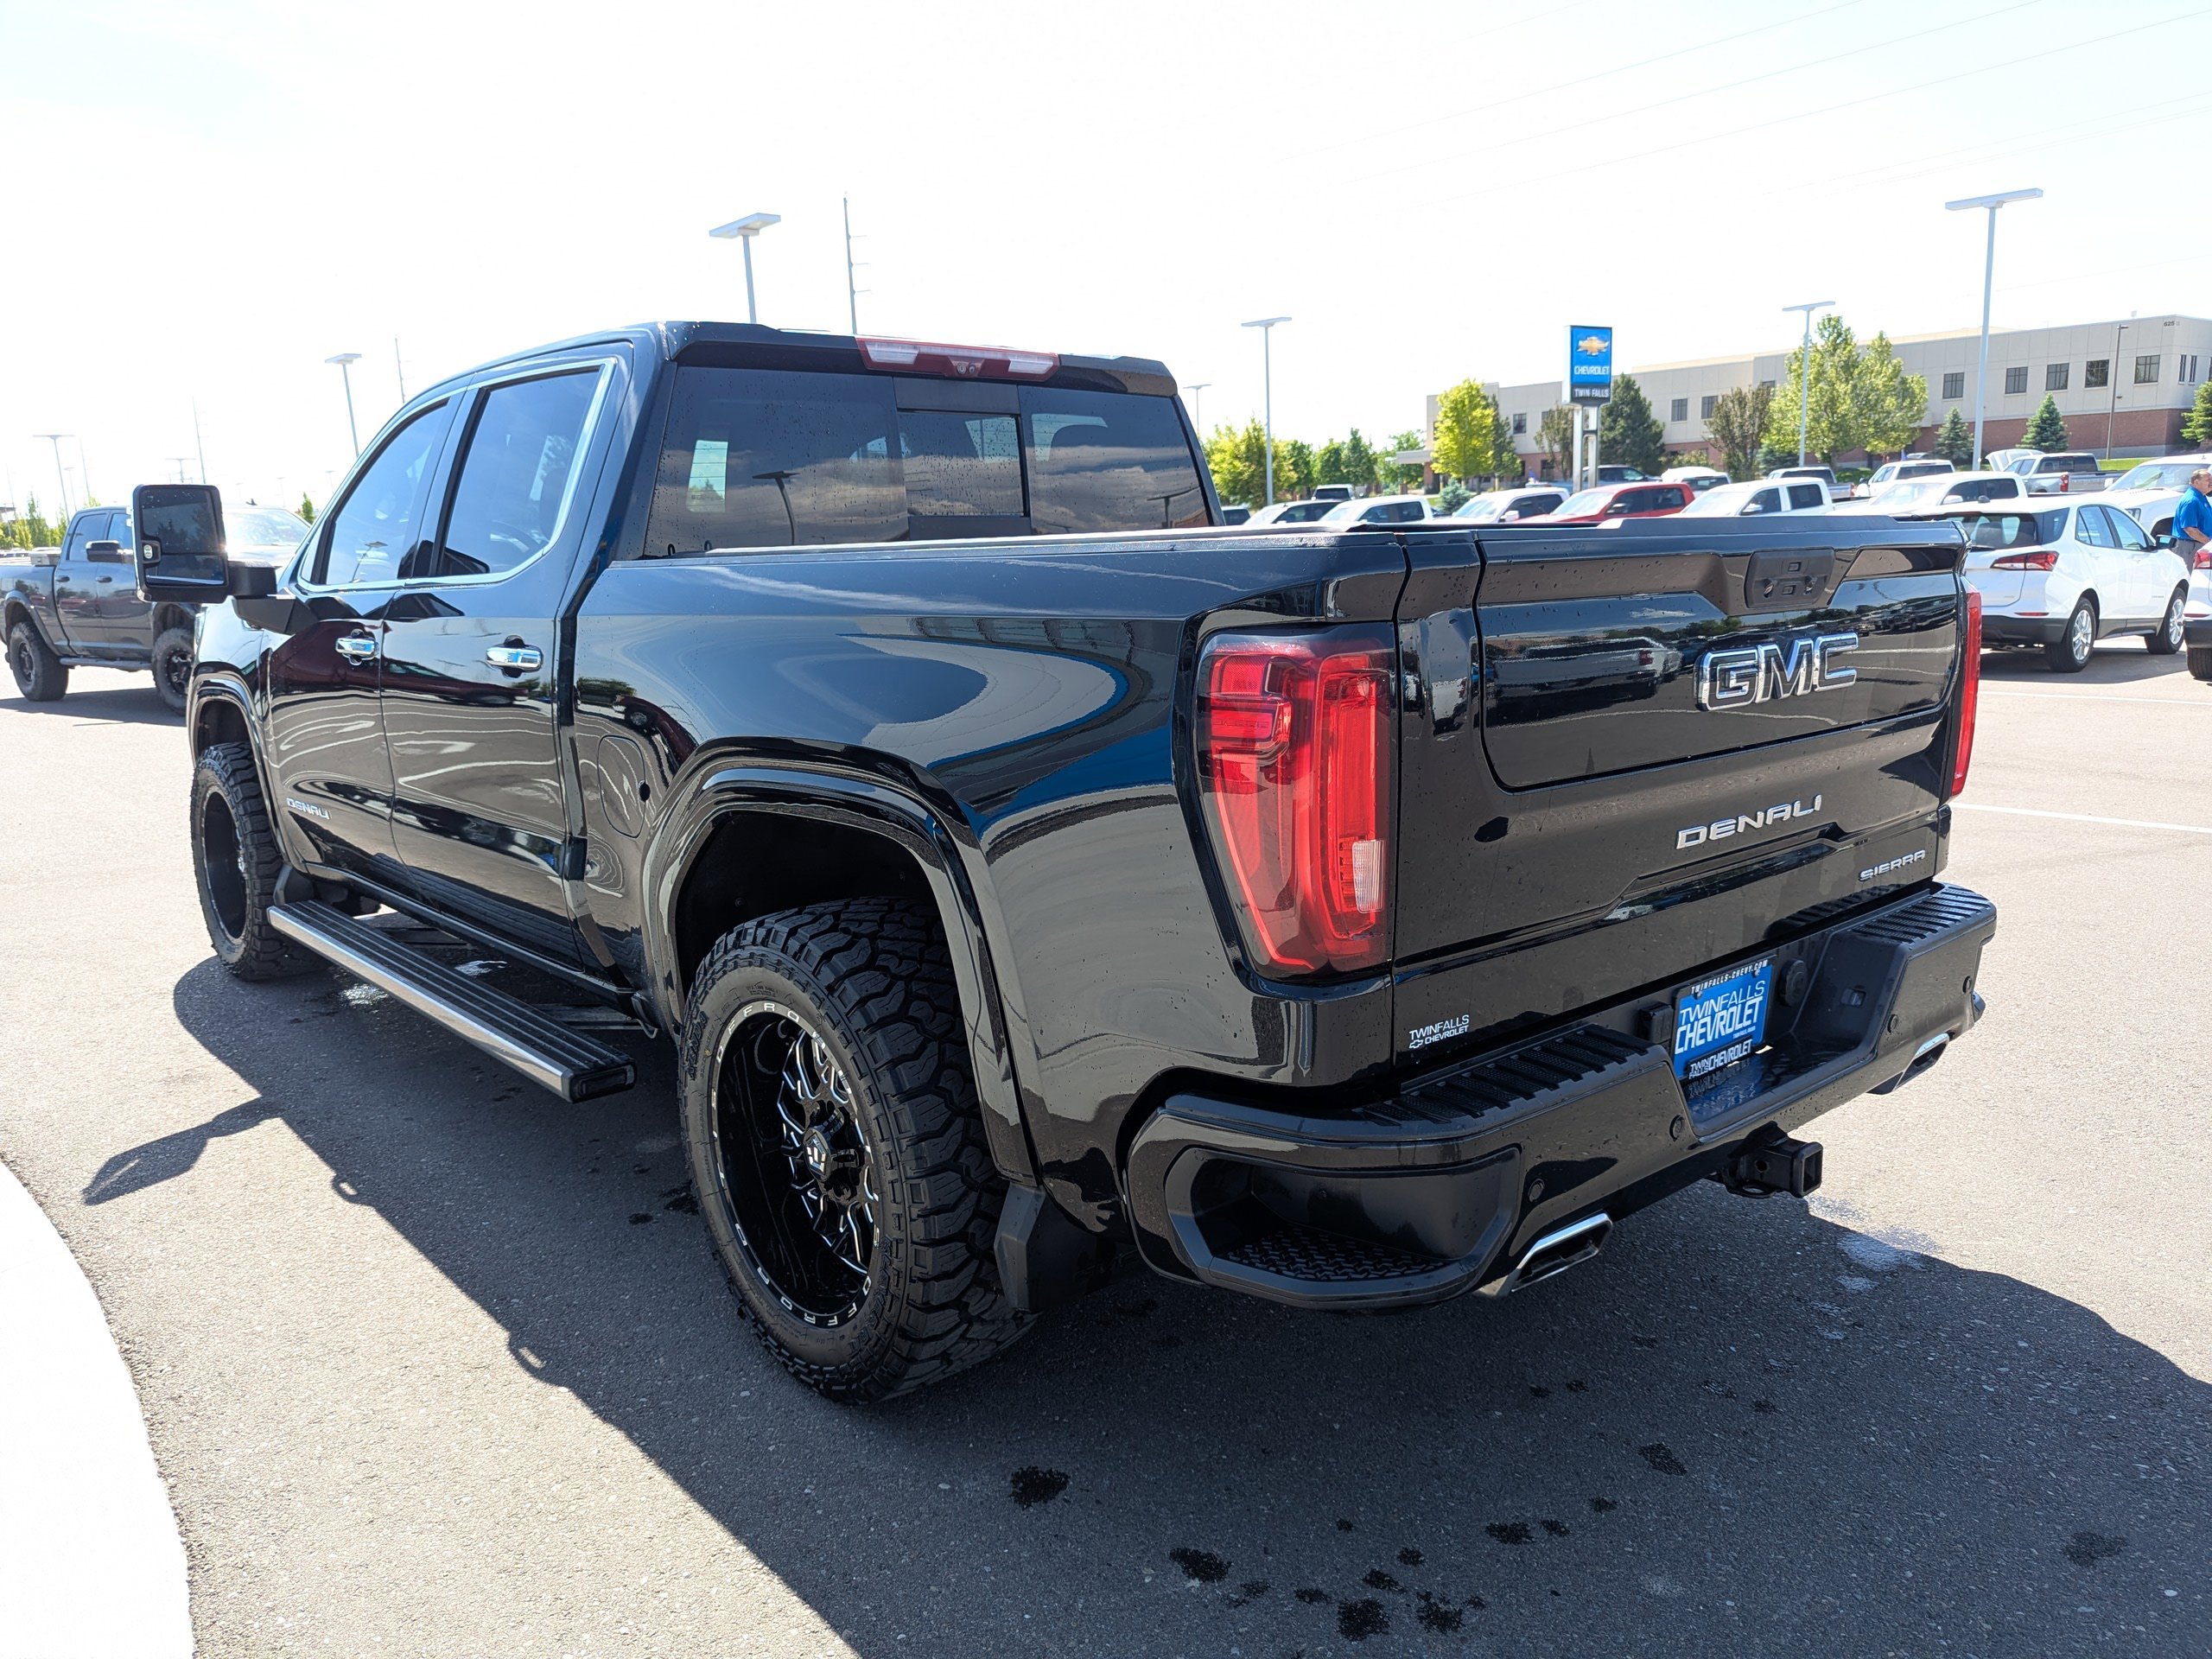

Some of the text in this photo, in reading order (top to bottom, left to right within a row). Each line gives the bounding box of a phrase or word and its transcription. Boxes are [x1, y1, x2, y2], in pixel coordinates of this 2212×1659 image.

[1573, 365, 1610, 375] CHEVROLET
[1574, 388, 1609, 397] TWIN FALLS
[1695, 632, 1858, 711] GMC
[286, 798, 330, 820] DENALI
[1675, 794, 1822, 850] DENALI
[1858, 849, 1926, 881] SIERRA
[1680, 980, 1765, 1026] TWINFALLS
[1408, 1014, 1470, 1040] TWINFALLS
[1424, 1025, 1469, 1045] CHEVROLET
[1675, 995, 1764, 1055] CHEVROLET
[1708, 1039, 1753, 1071] CHEVROLET
